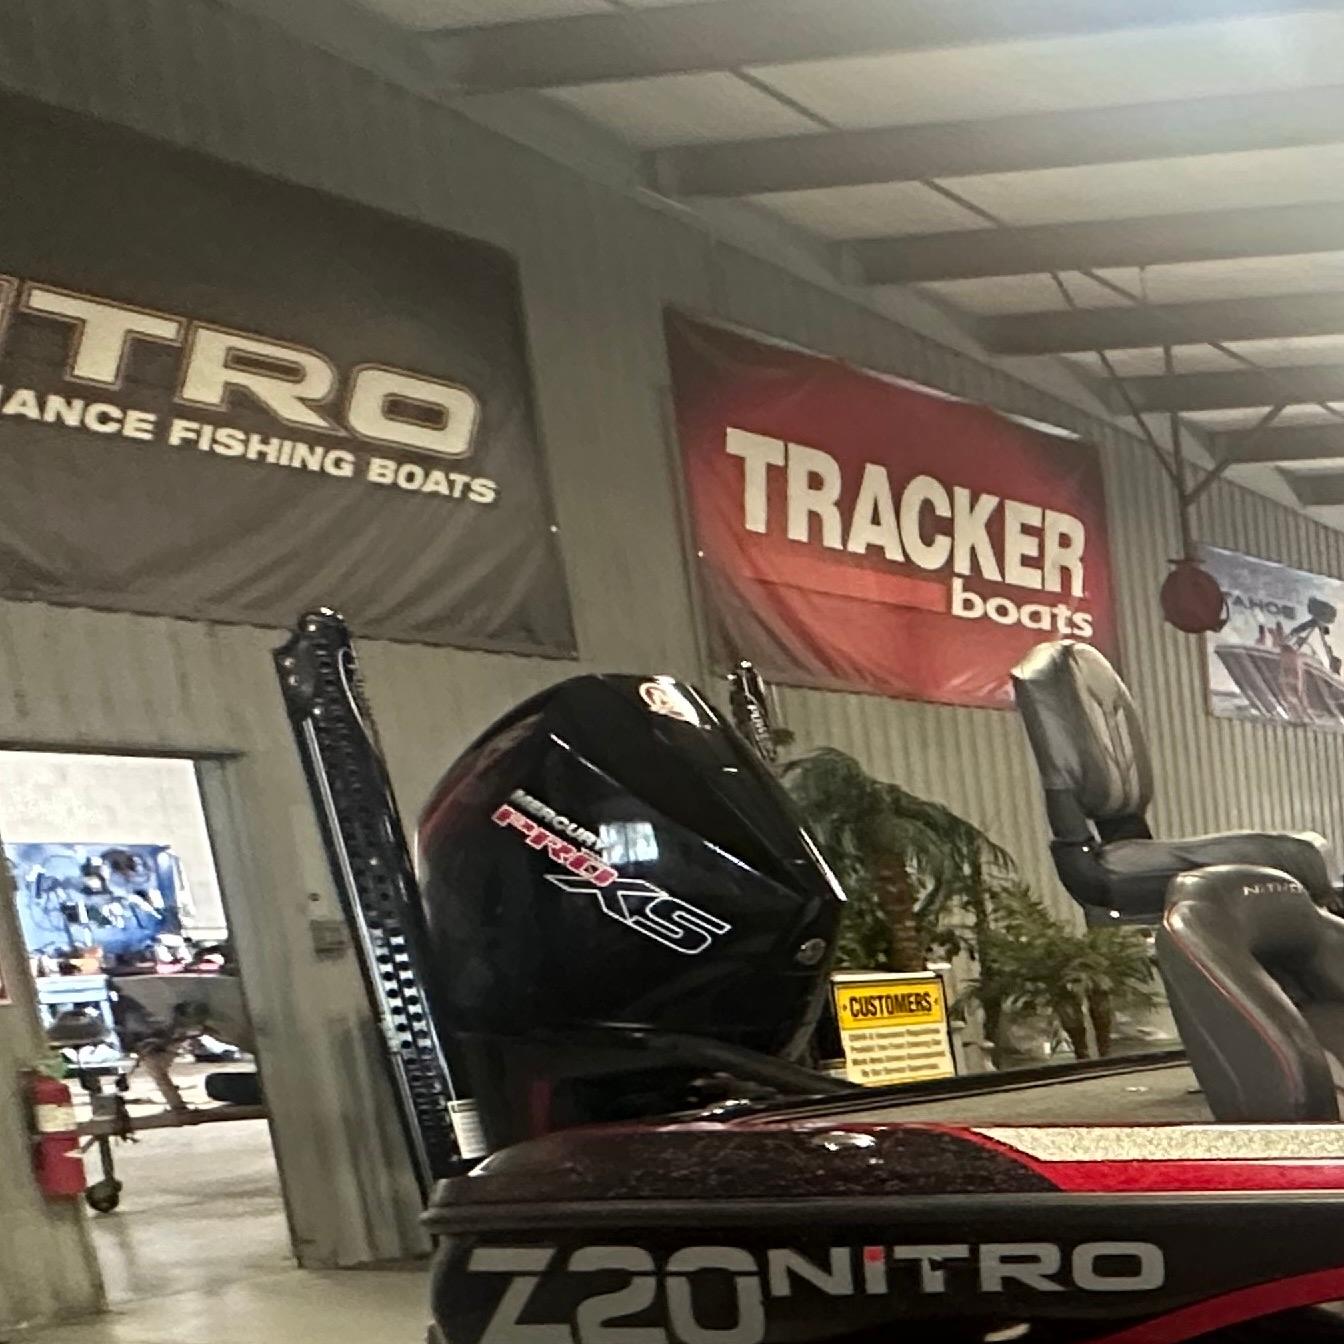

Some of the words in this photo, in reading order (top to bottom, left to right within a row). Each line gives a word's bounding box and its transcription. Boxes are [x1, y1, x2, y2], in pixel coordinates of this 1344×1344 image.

[0, 274, 480, 460] TRO
[0, 384, 157, 441] ANCE
[168, 415, 356, 478] FISHING
[367, 457, 499, 504] BOATS
[725, 427, 1086, 598] TRACKER
[951, 576, 1094, 638] boats
[491, 804, 619, 888] PRO
[543, 874, 732, 955] XS
[849, 991, 932, 1018] CUSTOMERS
